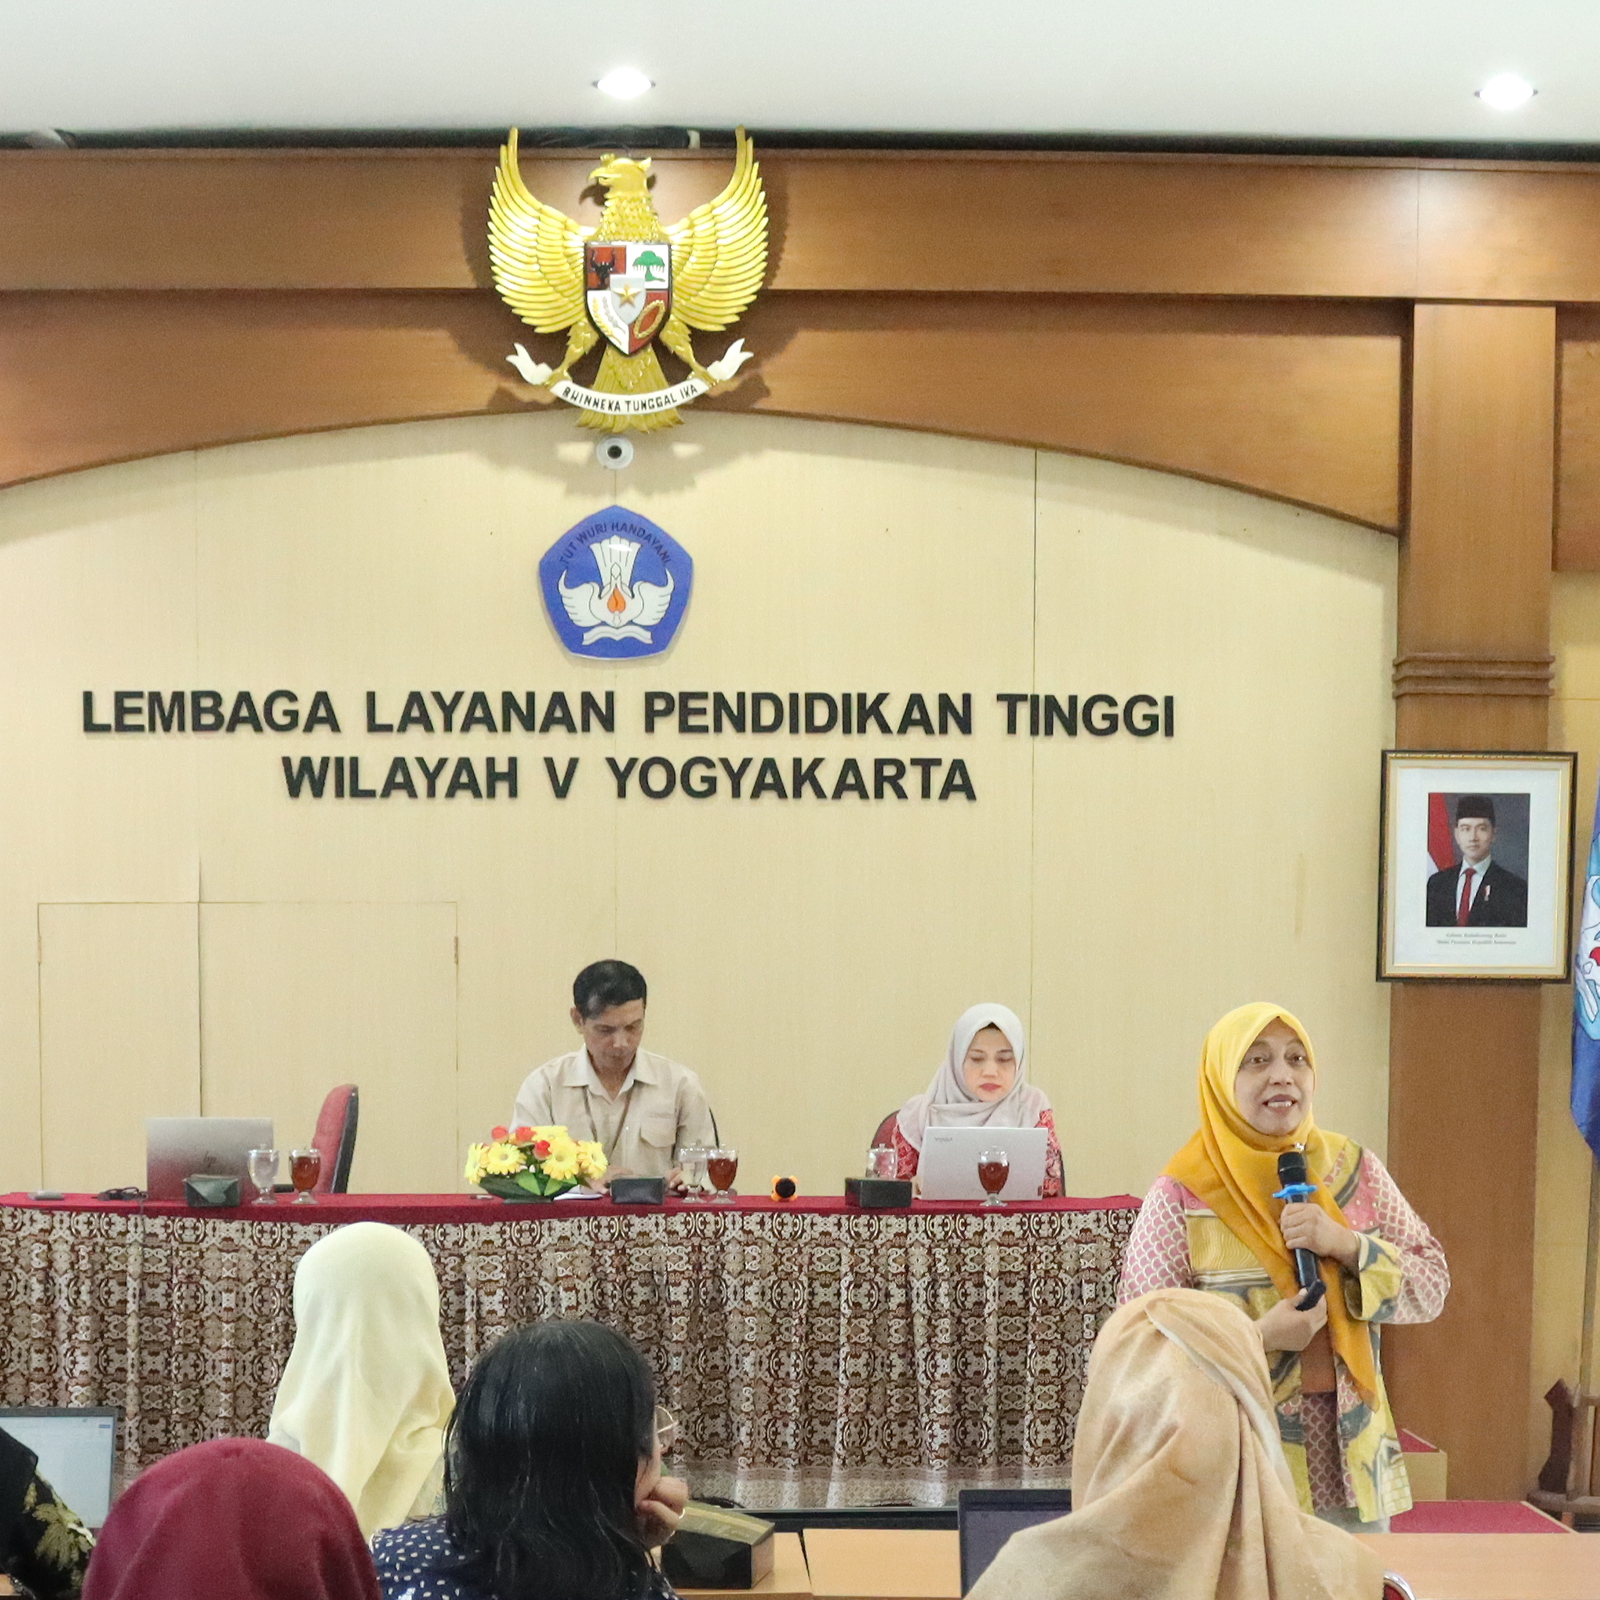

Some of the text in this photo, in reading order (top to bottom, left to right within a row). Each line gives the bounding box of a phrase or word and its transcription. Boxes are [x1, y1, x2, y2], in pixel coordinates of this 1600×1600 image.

[625, 396, 677, 412] TUNGGAL
[680, 384, 699, 400] IKA
[559, 522, 672, 567] TUT WURI HANDAYANI
[82, 690, 1175, 738] LEMBAGA LAYANAN PENDIDIKAN TINGGI
[281, 756, 978, 802] WILAYAH V YOGYAKARTA
